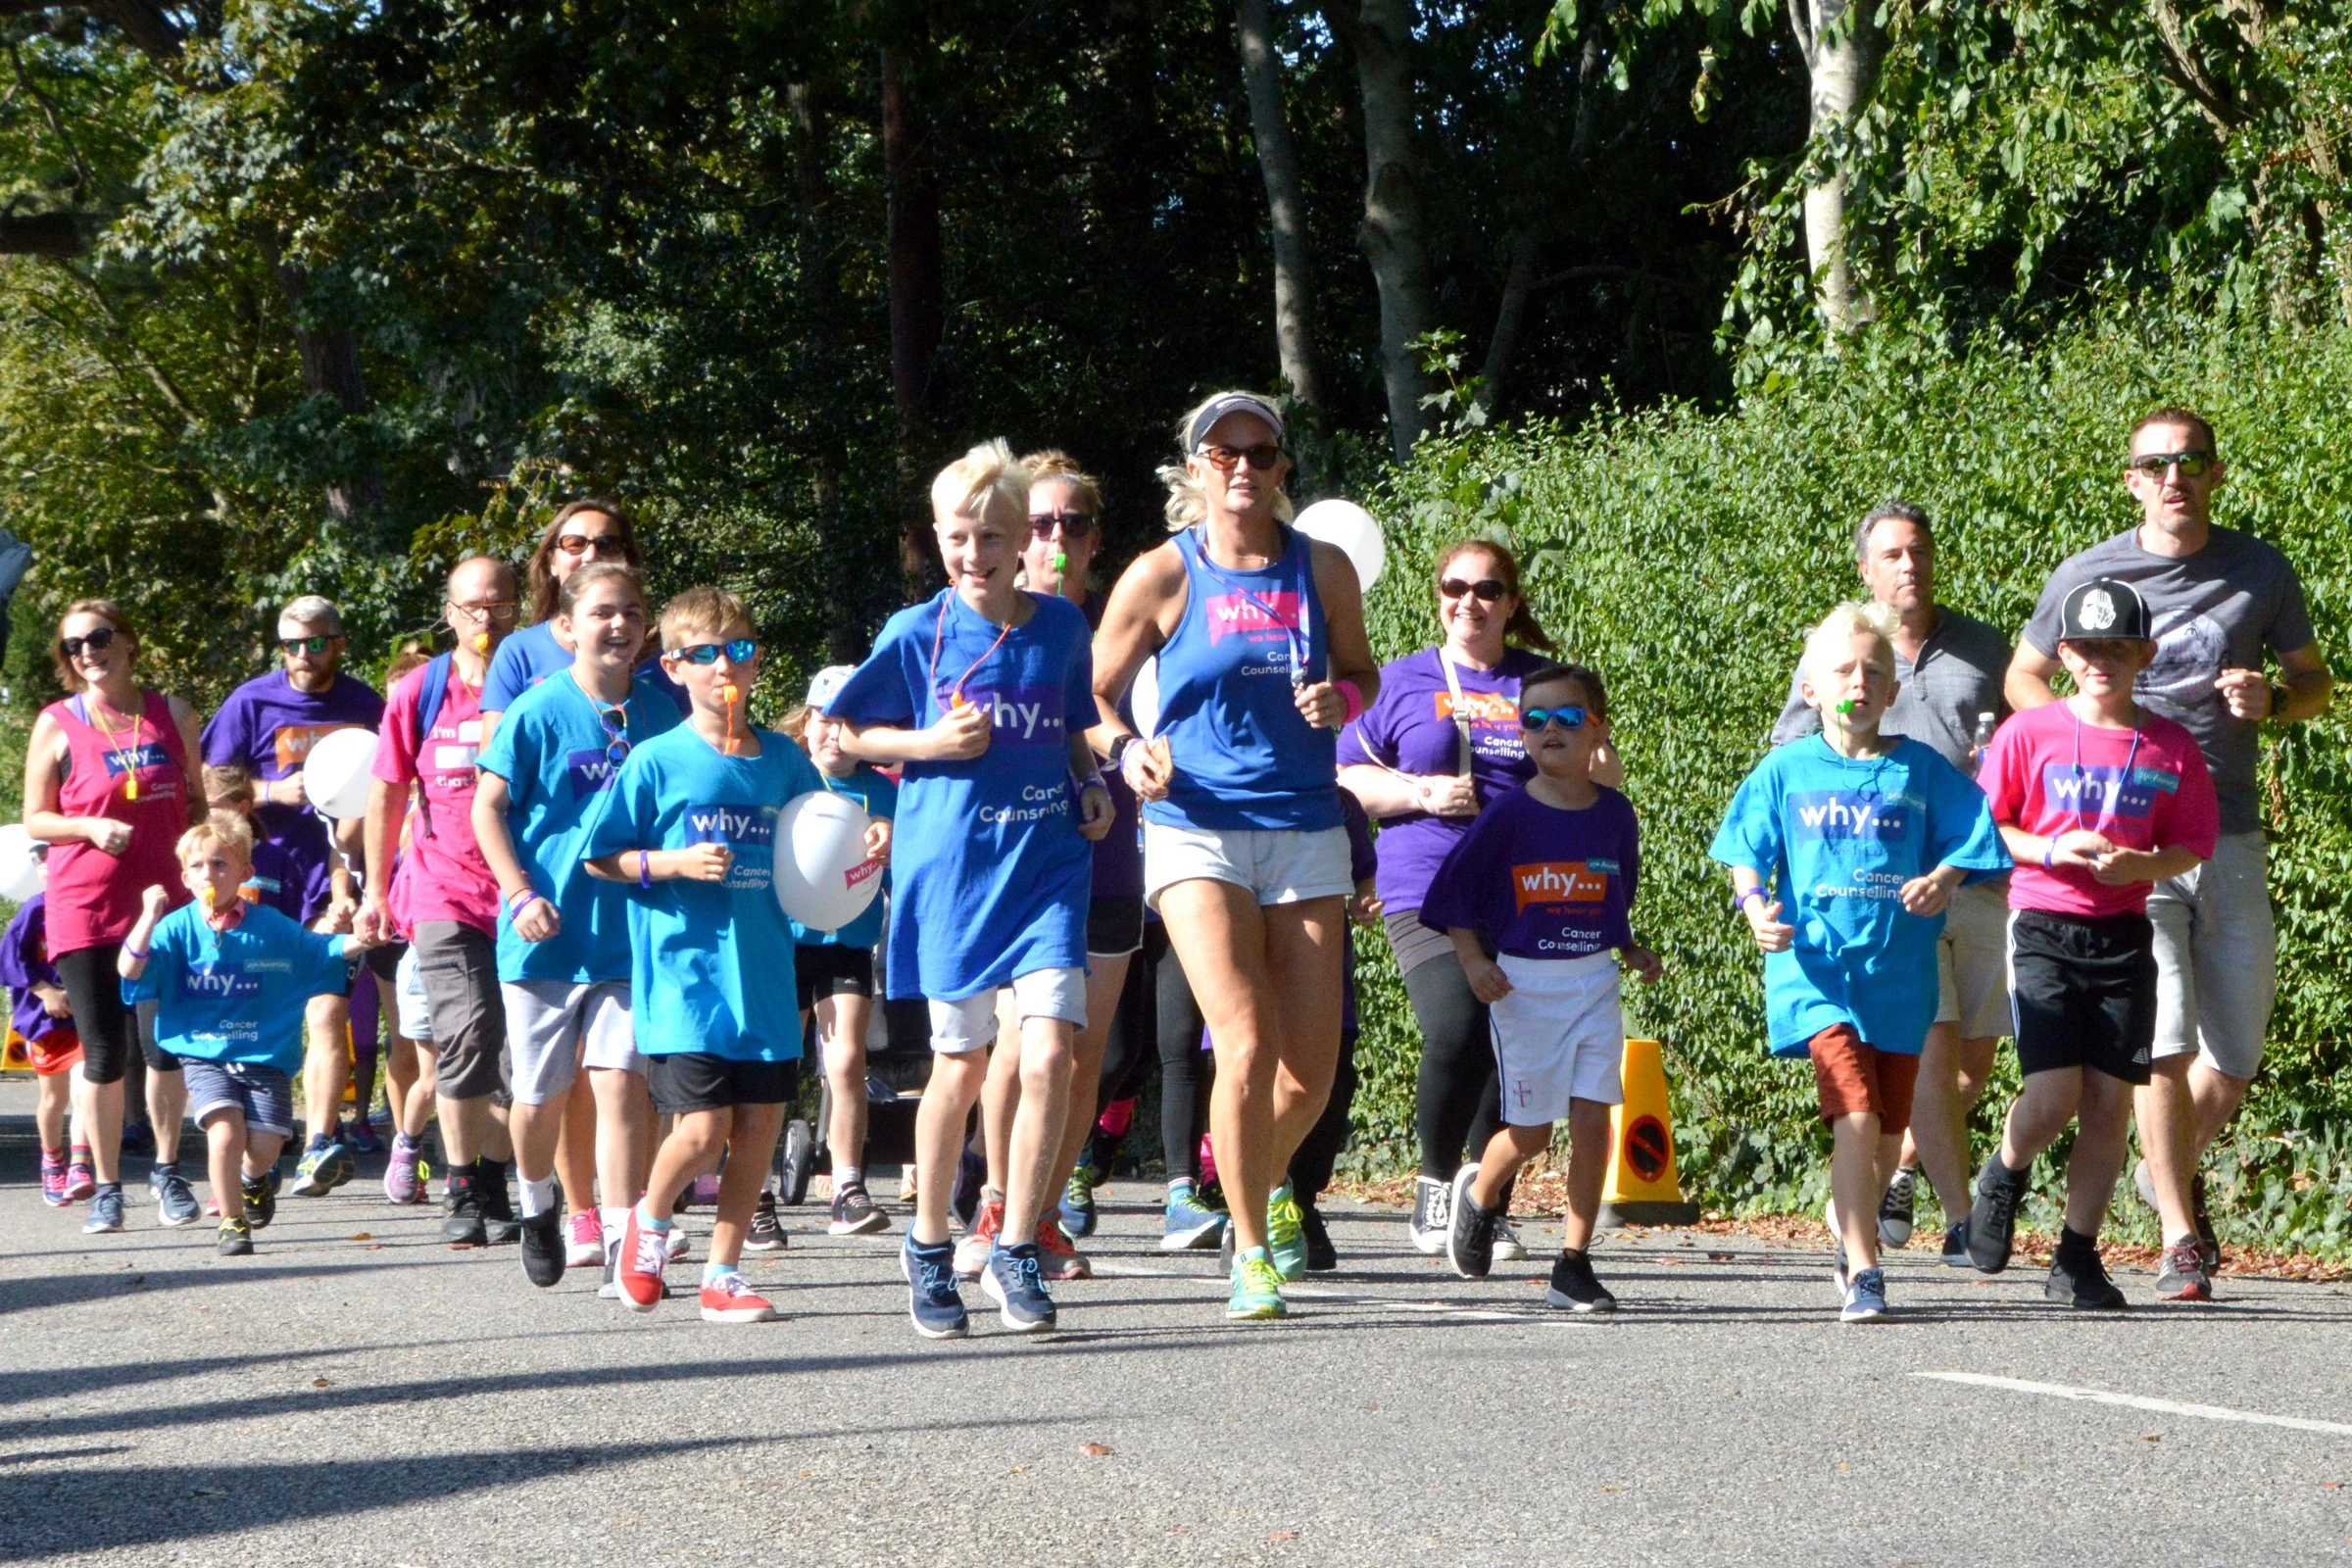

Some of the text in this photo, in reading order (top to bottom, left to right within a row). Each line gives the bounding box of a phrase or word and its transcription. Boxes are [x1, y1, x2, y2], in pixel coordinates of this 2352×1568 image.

[1470, 746, 1525, 760] ounselling
[691, 807, 770, 839] why...
[1799, 796, 1901, 835] why...
[1522, 866, 1601, 897] why...
[1561, 927, 1601, 939] Cancer
[186, 967, 258, 996] why...
[219, 1019, 258, 1029] Cancer
